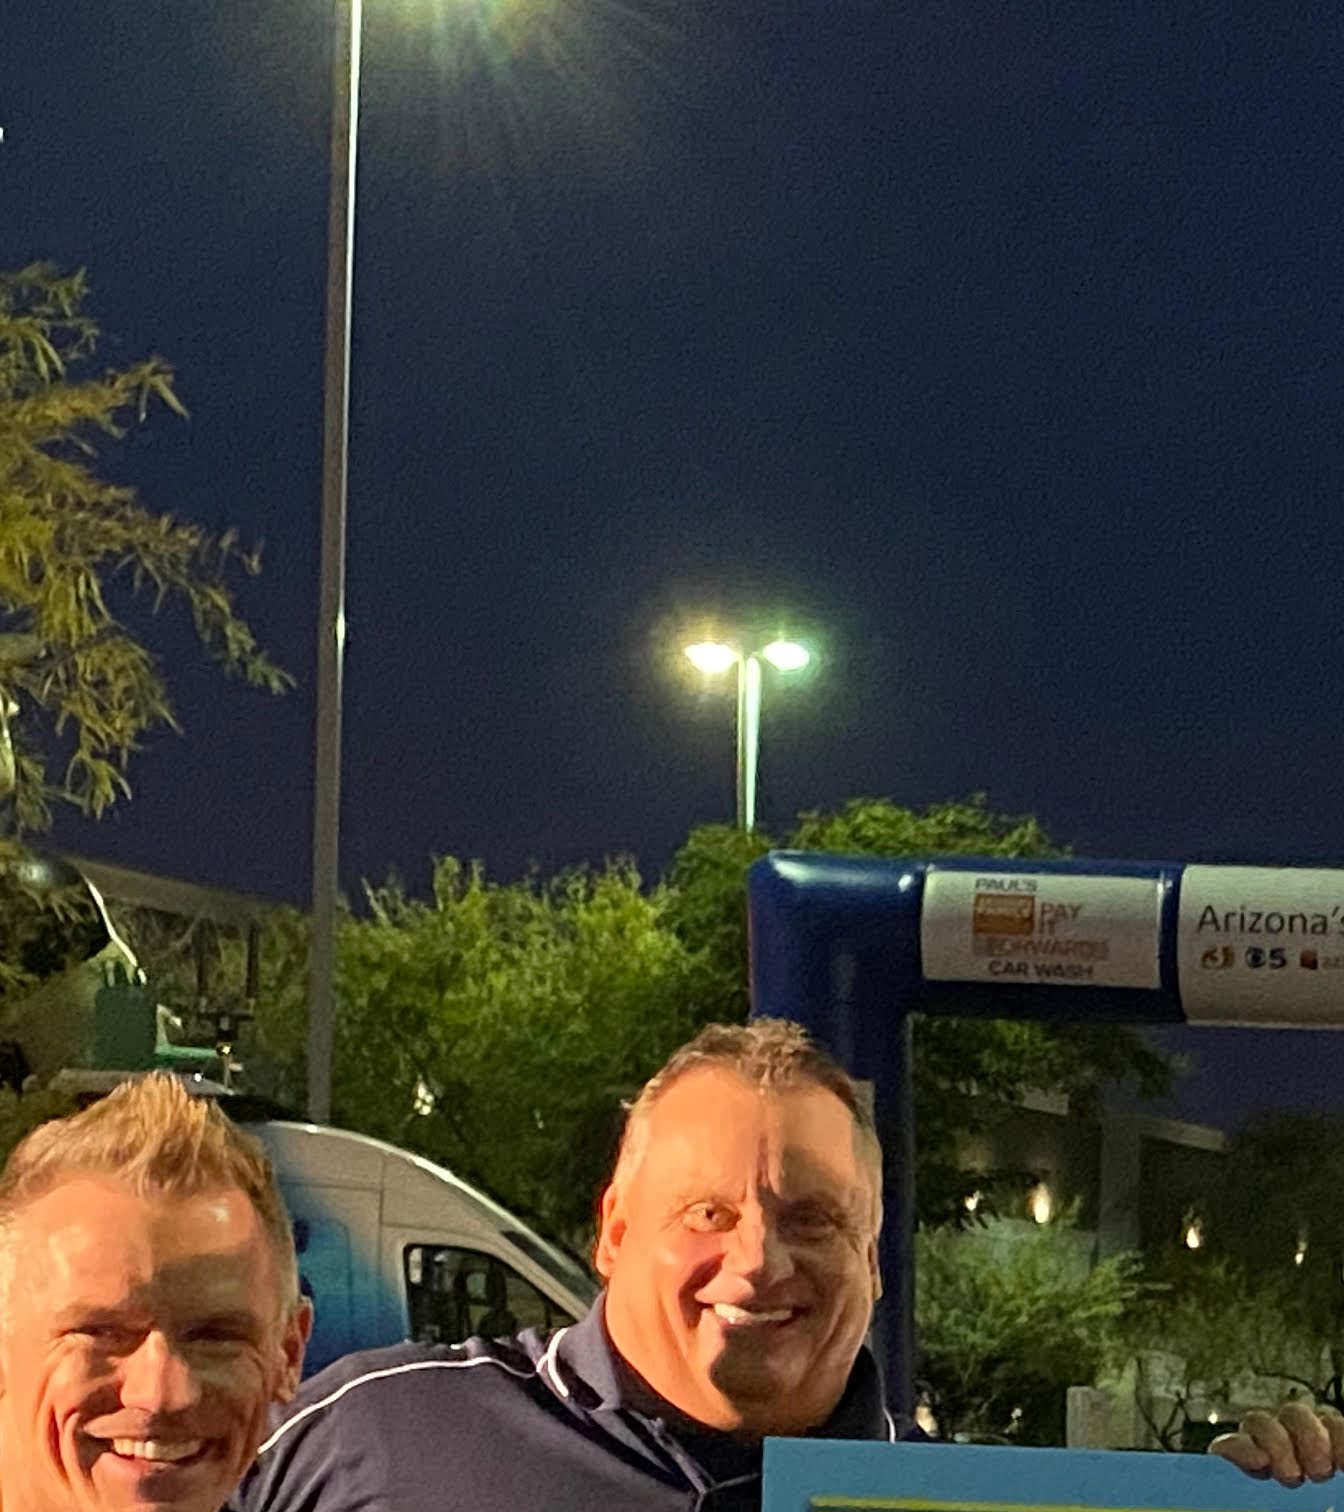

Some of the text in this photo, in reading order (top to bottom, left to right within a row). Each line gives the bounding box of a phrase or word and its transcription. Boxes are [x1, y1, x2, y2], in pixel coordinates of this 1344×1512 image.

[1041, 903, 1082, 921] PAY
[988, 960, 1093, 979] CAR WASH
